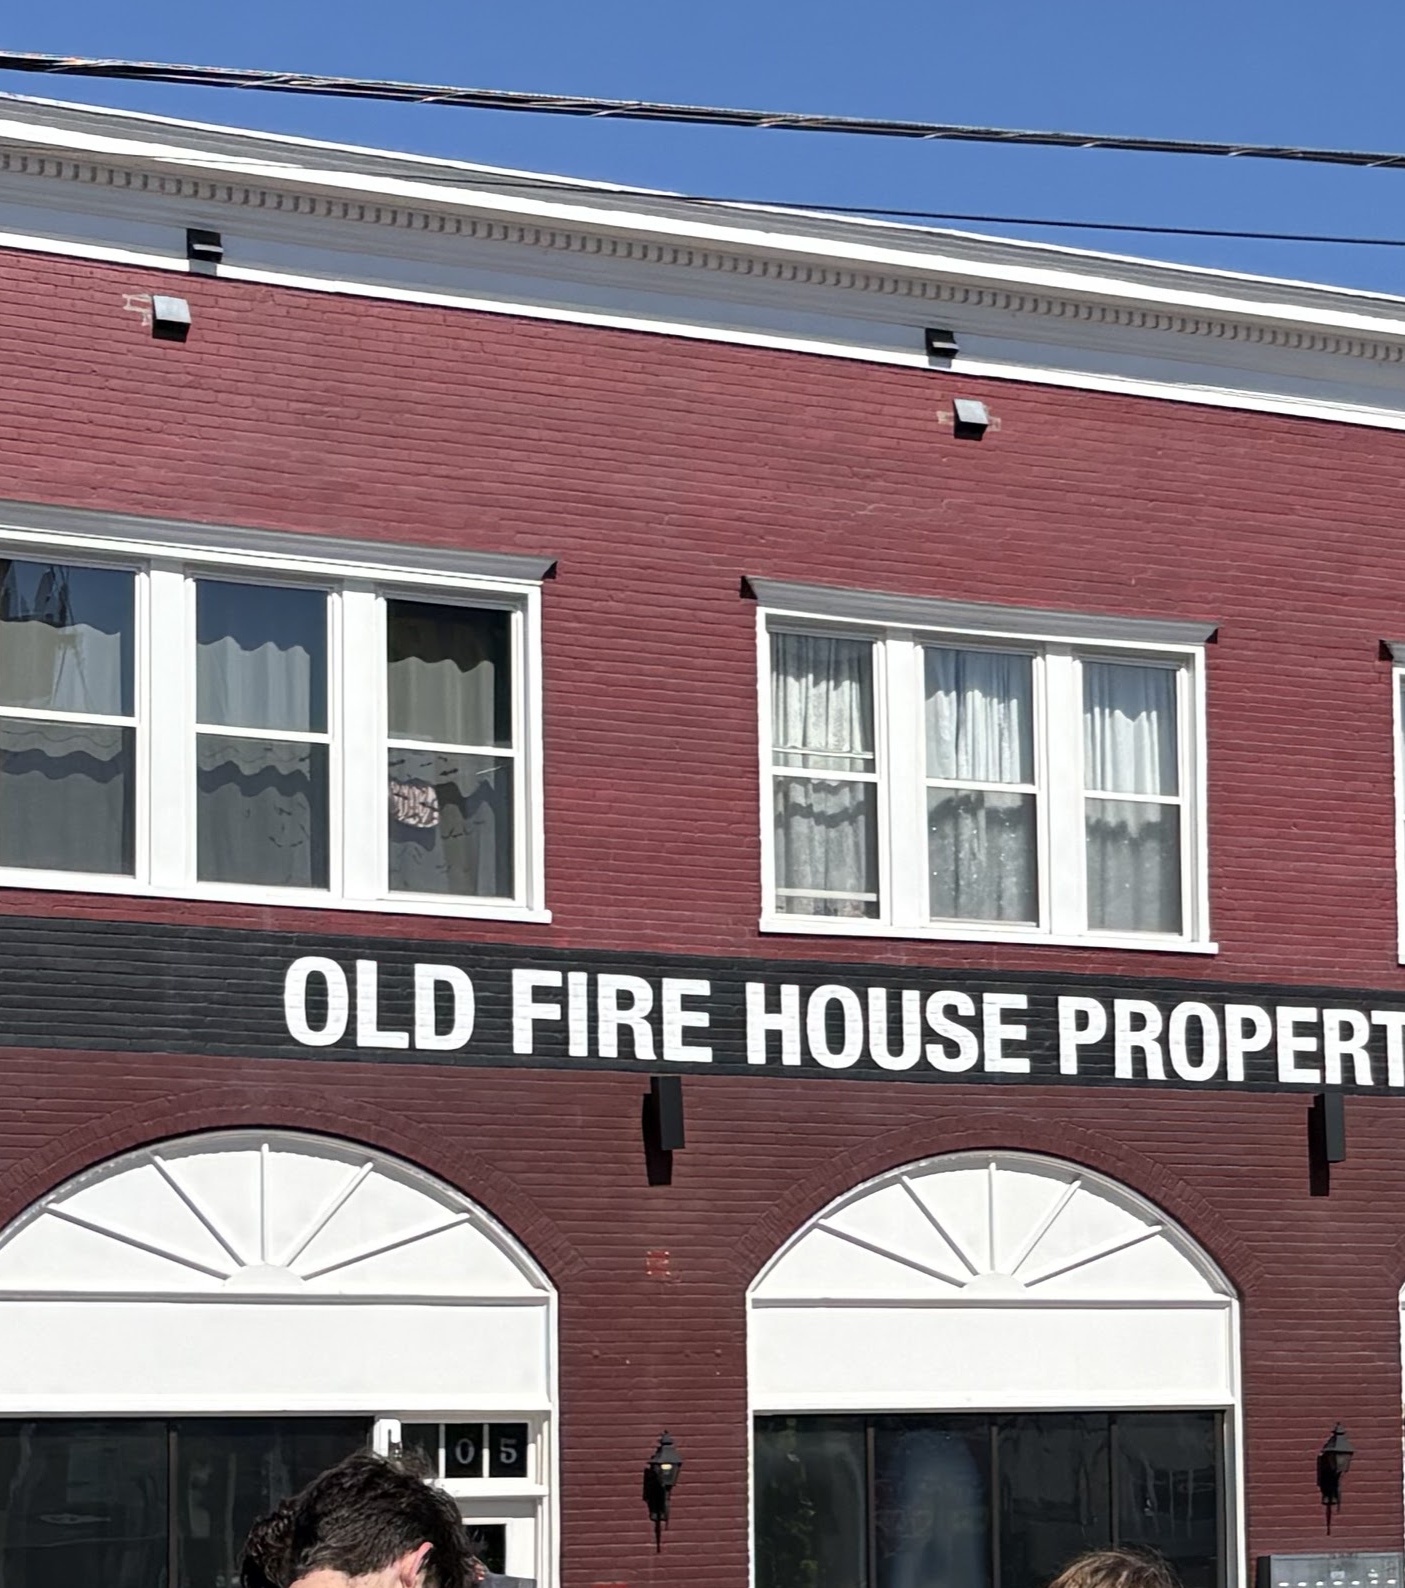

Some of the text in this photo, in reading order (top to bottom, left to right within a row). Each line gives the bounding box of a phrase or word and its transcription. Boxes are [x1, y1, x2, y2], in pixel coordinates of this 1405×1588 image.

[283, 956, 475, 1051] OLD
[512, 968, 713, 1063] FIRE
[746, 981, 1030, 1073] HOUSE
